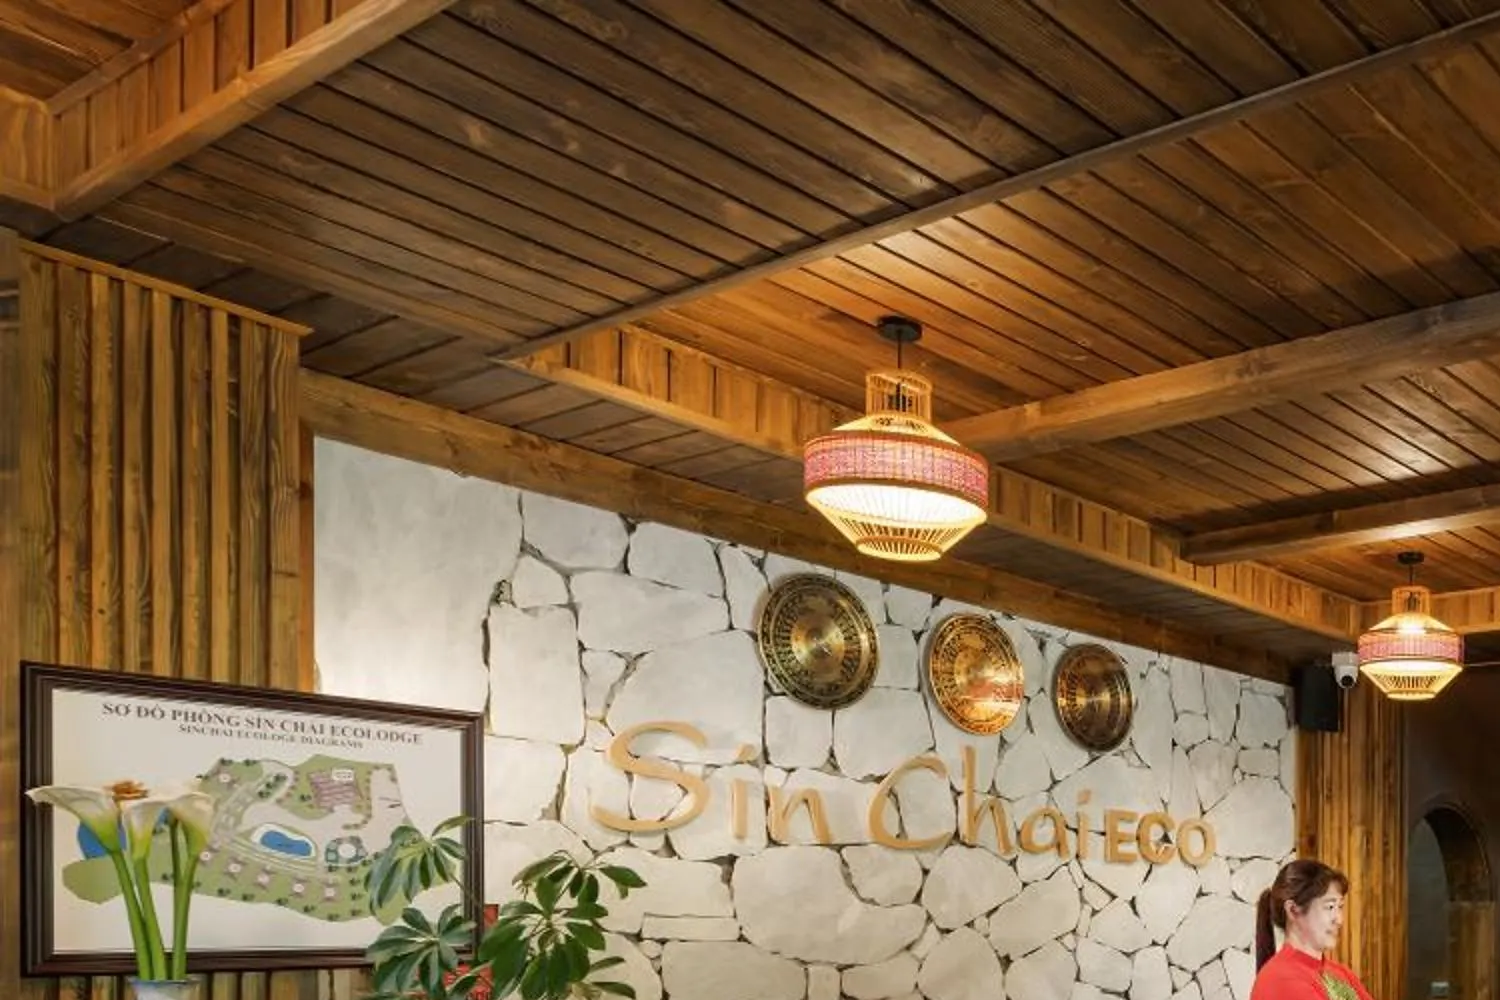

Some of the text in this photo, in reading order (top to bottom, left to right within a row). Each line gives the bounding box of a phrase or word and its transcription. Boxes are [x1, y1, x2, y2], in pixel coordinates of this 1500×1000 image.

[331, 725, 422, 744] ECOLODGE
[868, 745, 1094, 862] Chai
[1102, 806, 1217, 867] ECO
